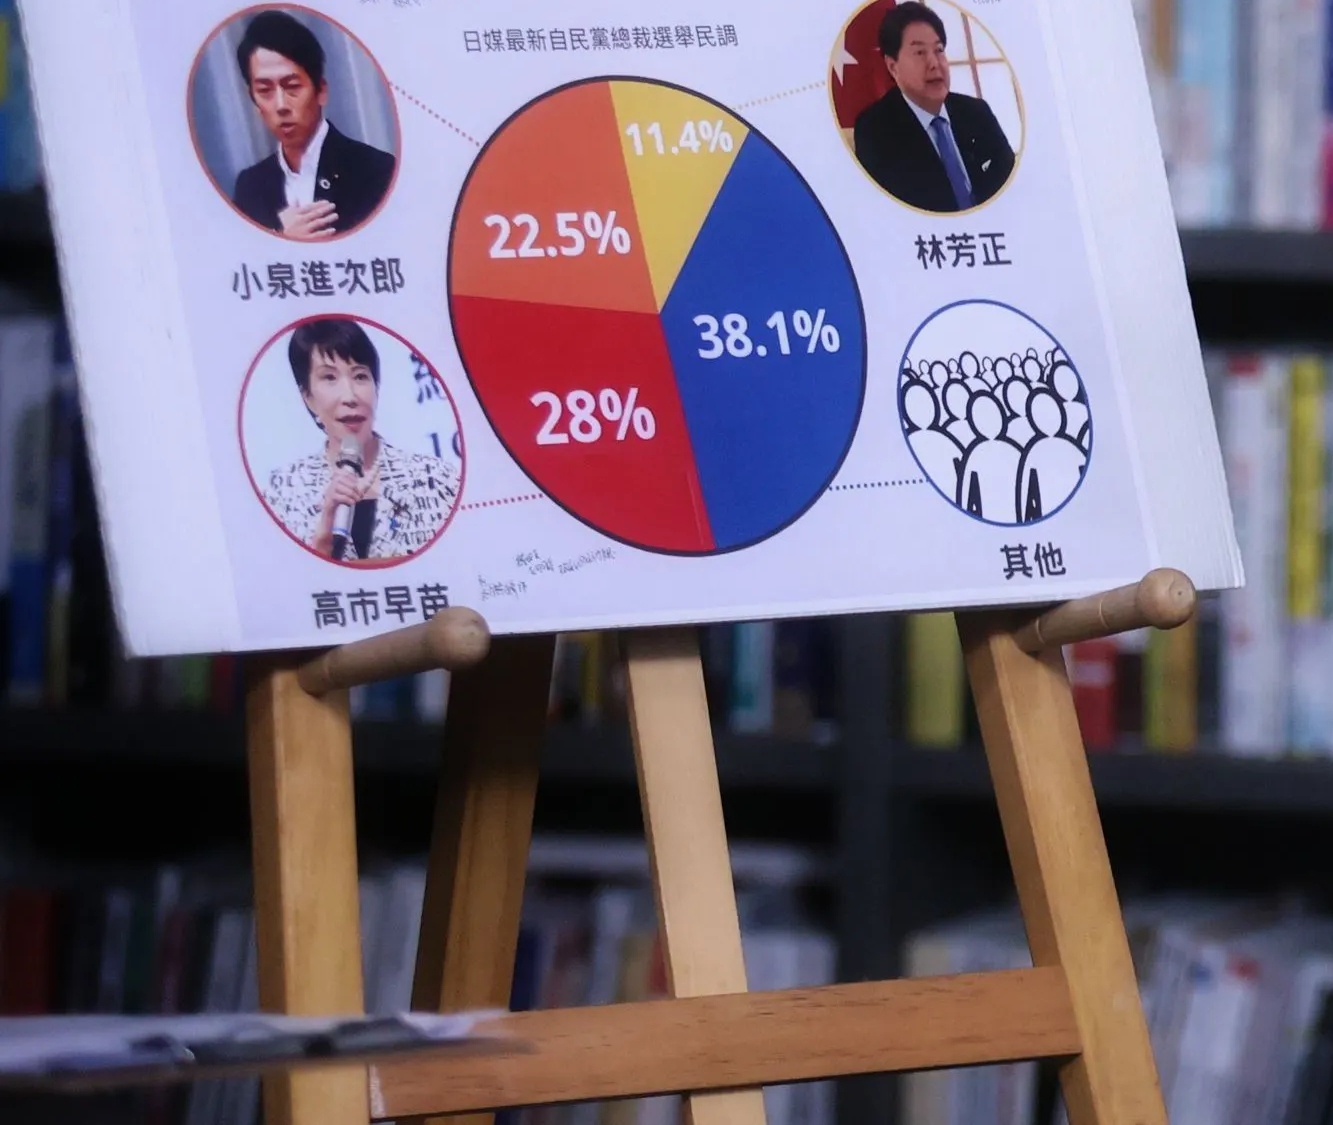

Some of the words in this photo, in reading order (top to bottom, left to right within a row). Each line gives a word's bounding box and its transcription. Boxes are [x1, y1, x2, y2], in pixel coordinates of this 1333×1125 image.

[463, 24, 739, 53] 日媒最新自民黨總裁選舉民調
[625, 119, 734, 156] 11.4%
[485, 210, 632, 260] 22.5%
[914, 232, 1012, 270] 林芳正
[232, 257, 405, 301] 小泉進次郎
[692, 308, 841, 360] 38.1%
[530, 387, 656, 445] 28%
[1000, 542, 1067, 580] 其他
[312, 582, 450, 629] 高市早苗
